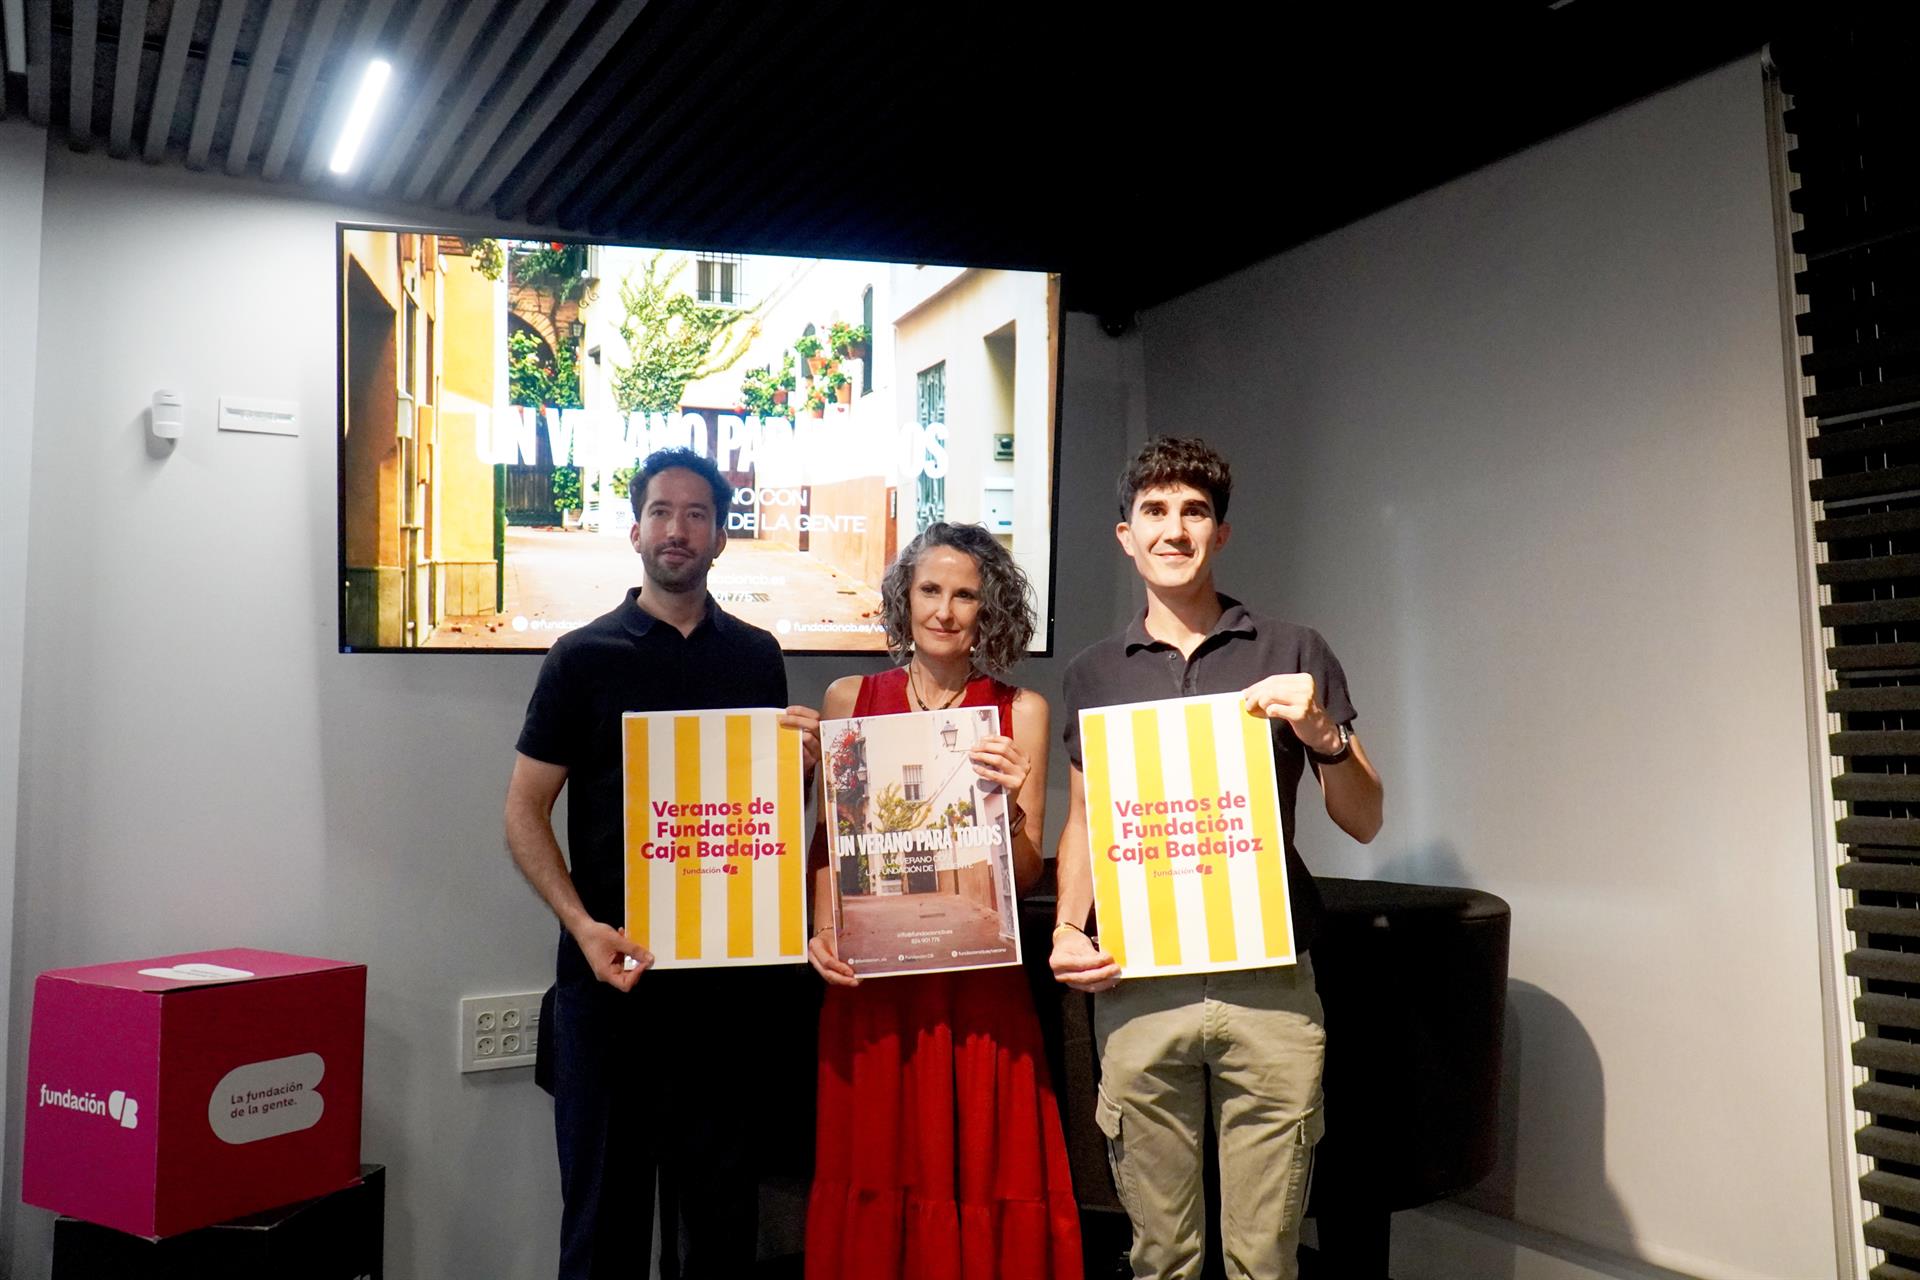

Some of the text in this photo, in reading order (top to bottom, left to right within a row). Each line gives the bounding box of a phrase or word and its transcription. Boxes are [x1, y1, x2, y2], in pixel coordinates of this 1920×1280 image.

[476, 406, 537, 466] UN
[545, 408, 708, 470] VANO
[759, 488, 808, 507] CON
[727, 512, 867, 533] DE LA GENTE
[652, 796, 775, 818] Veranos de
[1115, 791, 1247, 817] Veranos de
[656, 817, 771, 838] Fundación
[1121, 814, 1244, 839] Fundación
[640, 838, 787, 863] Caja Badajoz
[835, 824, 1003, 857] UN VERANO PARA TODOS
[1107, 834, 1264, 865] Caja Badajoz
[682, 865, 721, 876] fundación
[923, 864, 934, 873] DE
[39, 1083, 106, 1116] fundación
[231, 1081, 304, 1105] La fundación
[230, 1097, 298, 1118] de la gente.
